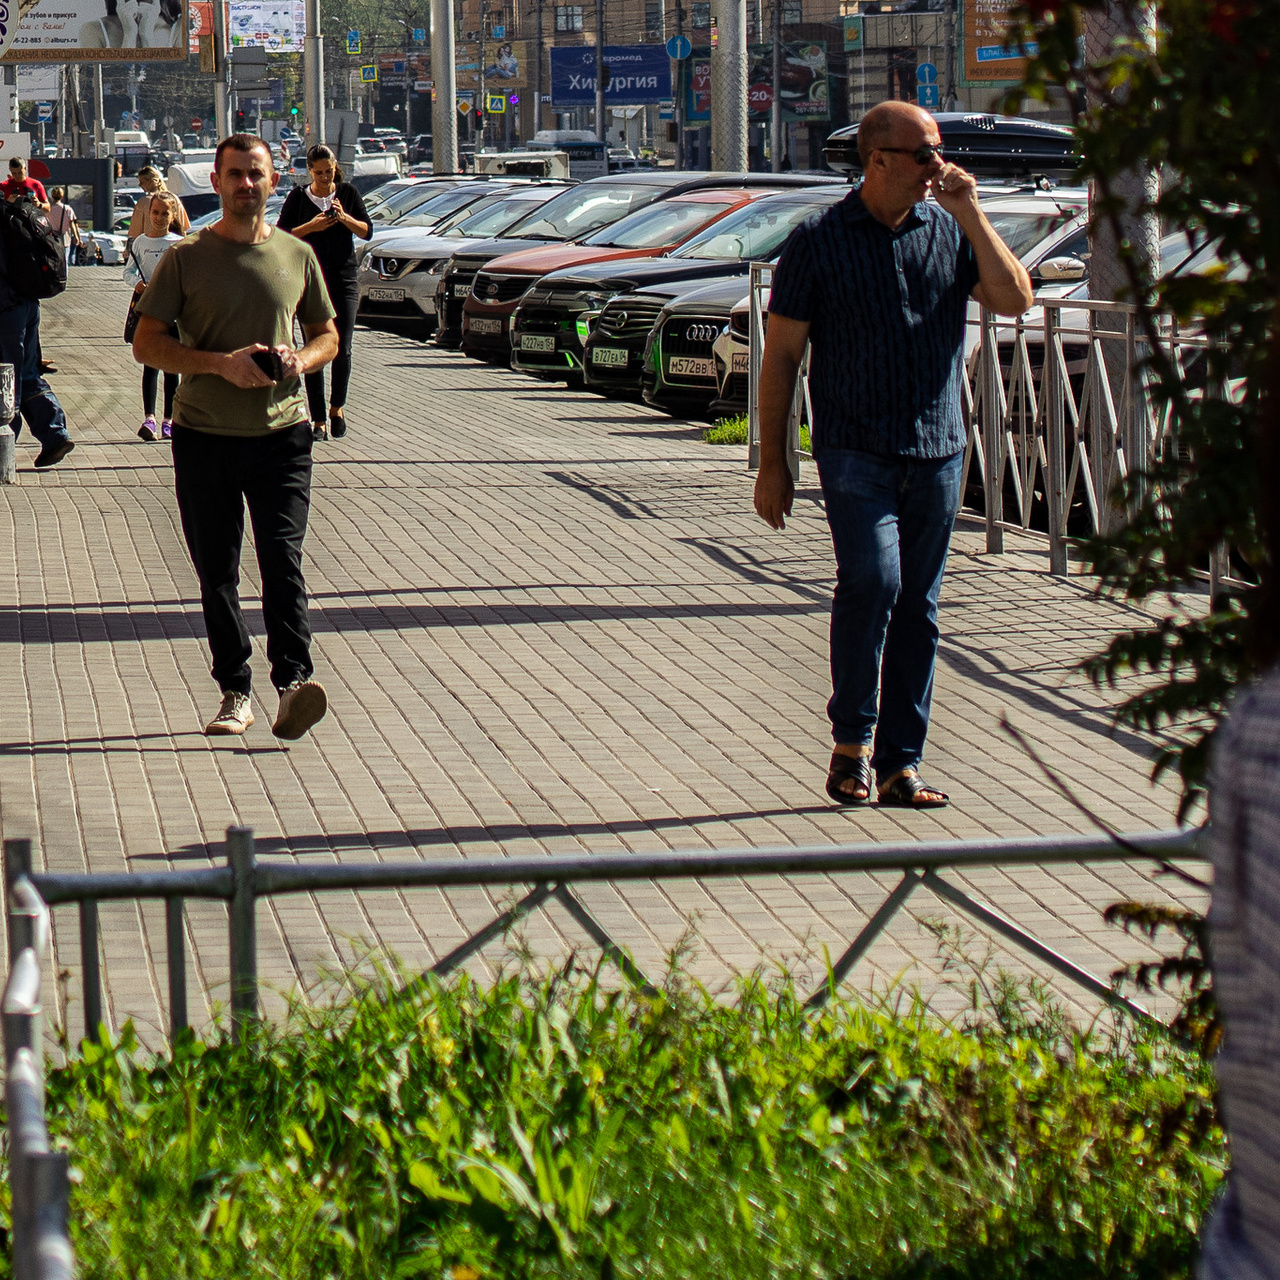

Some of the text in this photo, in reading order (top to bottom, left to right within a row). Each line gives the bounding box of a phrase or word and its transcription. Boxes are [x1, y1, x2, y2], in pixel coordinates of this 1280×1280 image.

[53, 12, 77, 20] прикуса
[602, 54, 643, 63] вромед
[671, 357, 708, 374] М572ВВ
